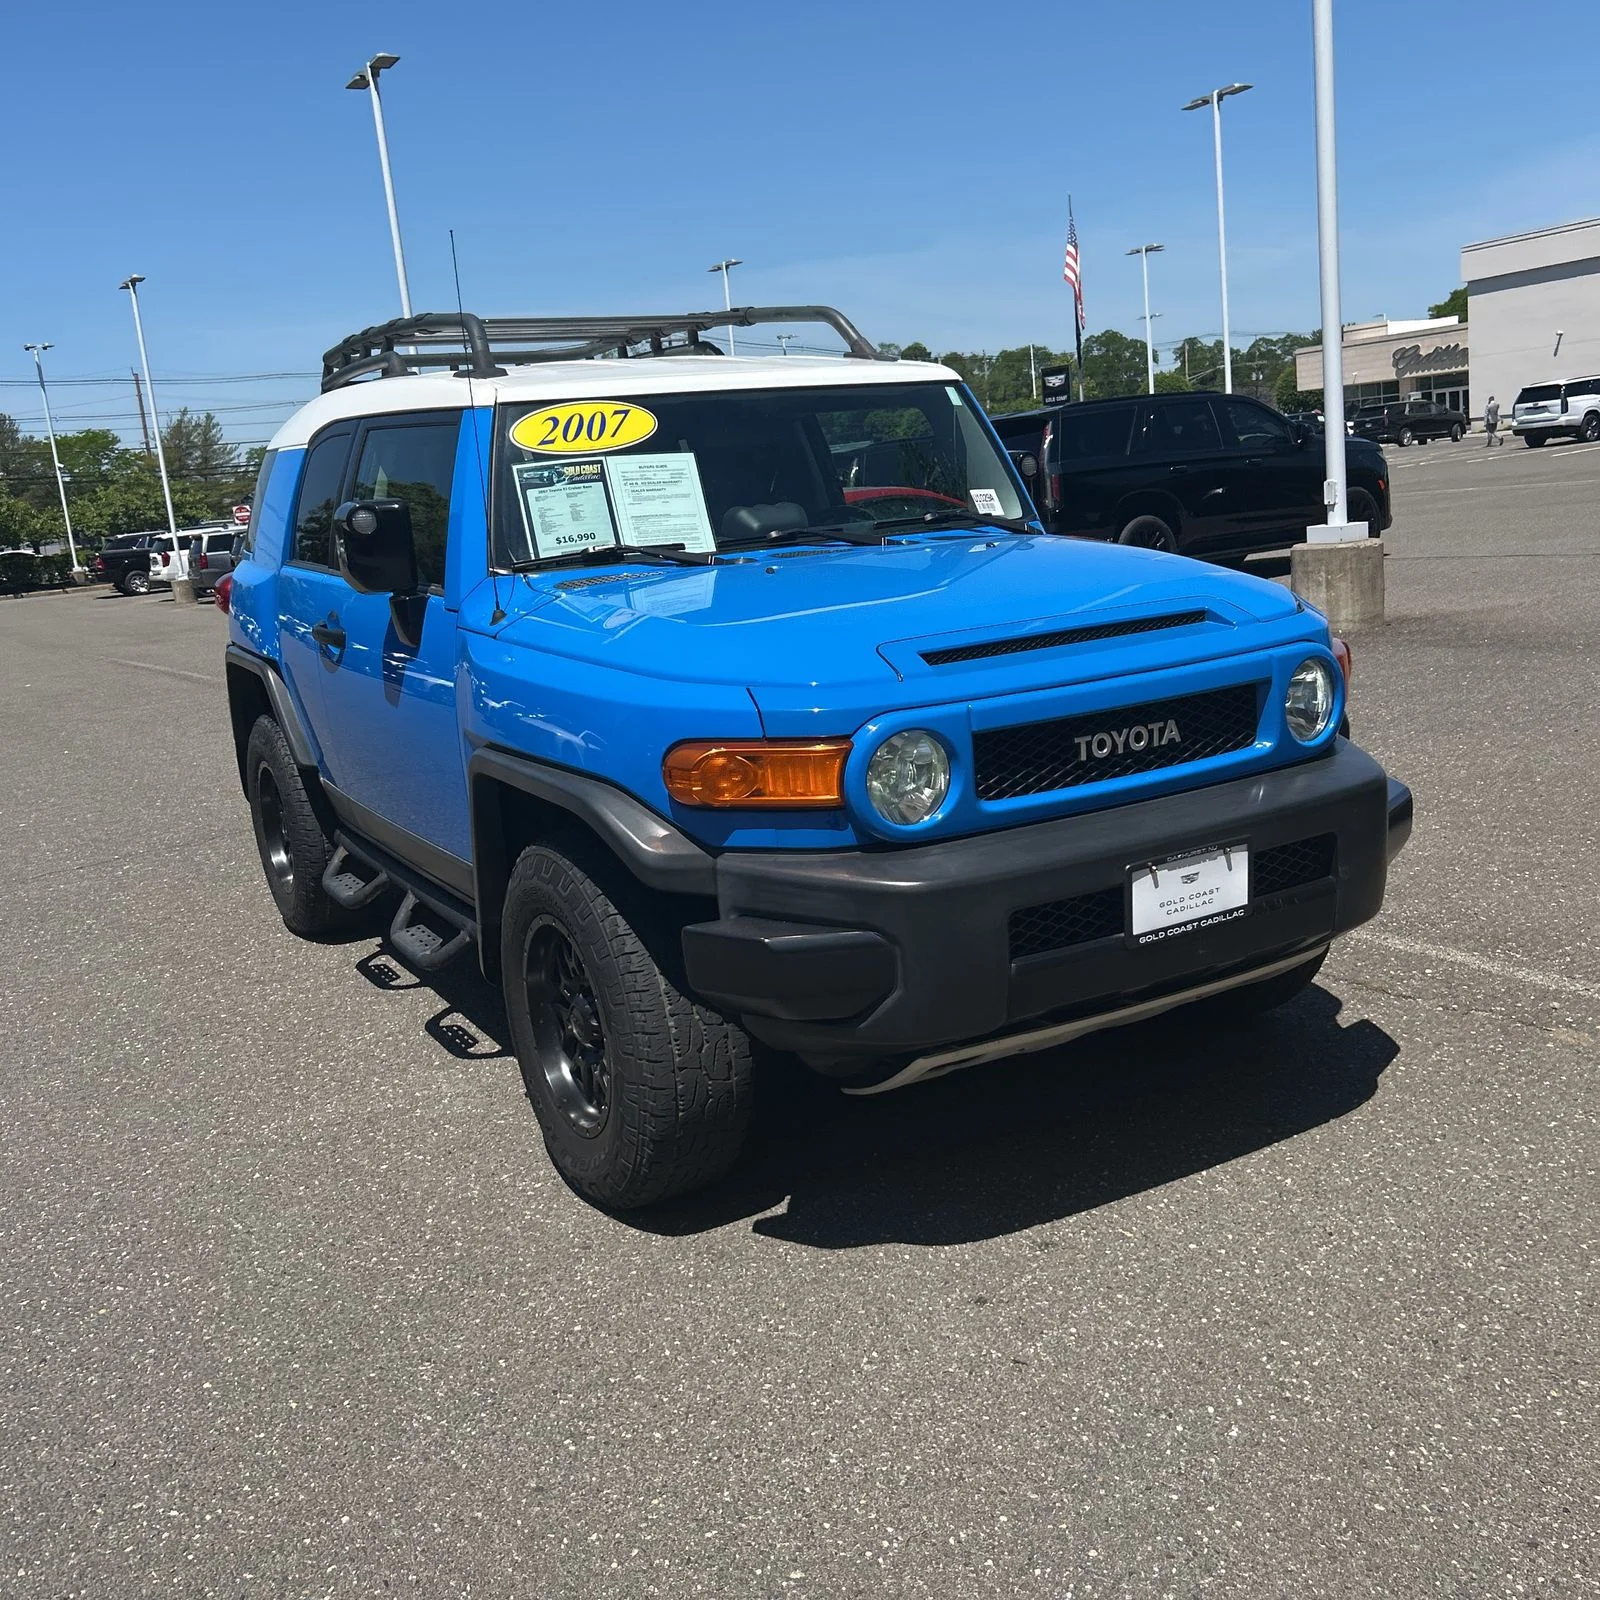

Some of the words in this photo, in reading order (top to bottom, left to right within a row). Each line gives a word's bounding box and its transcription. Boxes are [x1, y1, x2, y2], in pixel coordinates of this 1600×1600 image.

[1392, 342, 1469, 374] Cadilla
[537, 409, 632, 446] 2007
[563, 465, 580, 475] GOLD
[581, 464, 602, 474] COAST
[555, 532, 596, 545] $16,990
[1075, 719, 1182, 762] TOYOTA
[1159, 897, 1185, 909] GOLD
[1189, 887, 1221, 900] COAST
[1166, 898, 1214, 916] CADILLAC
[1139, 931, 1166, 944] GOLD
[1166, 921, 1199, 937] COAST
[1200, 909, 1245, 927] CADILLAC
